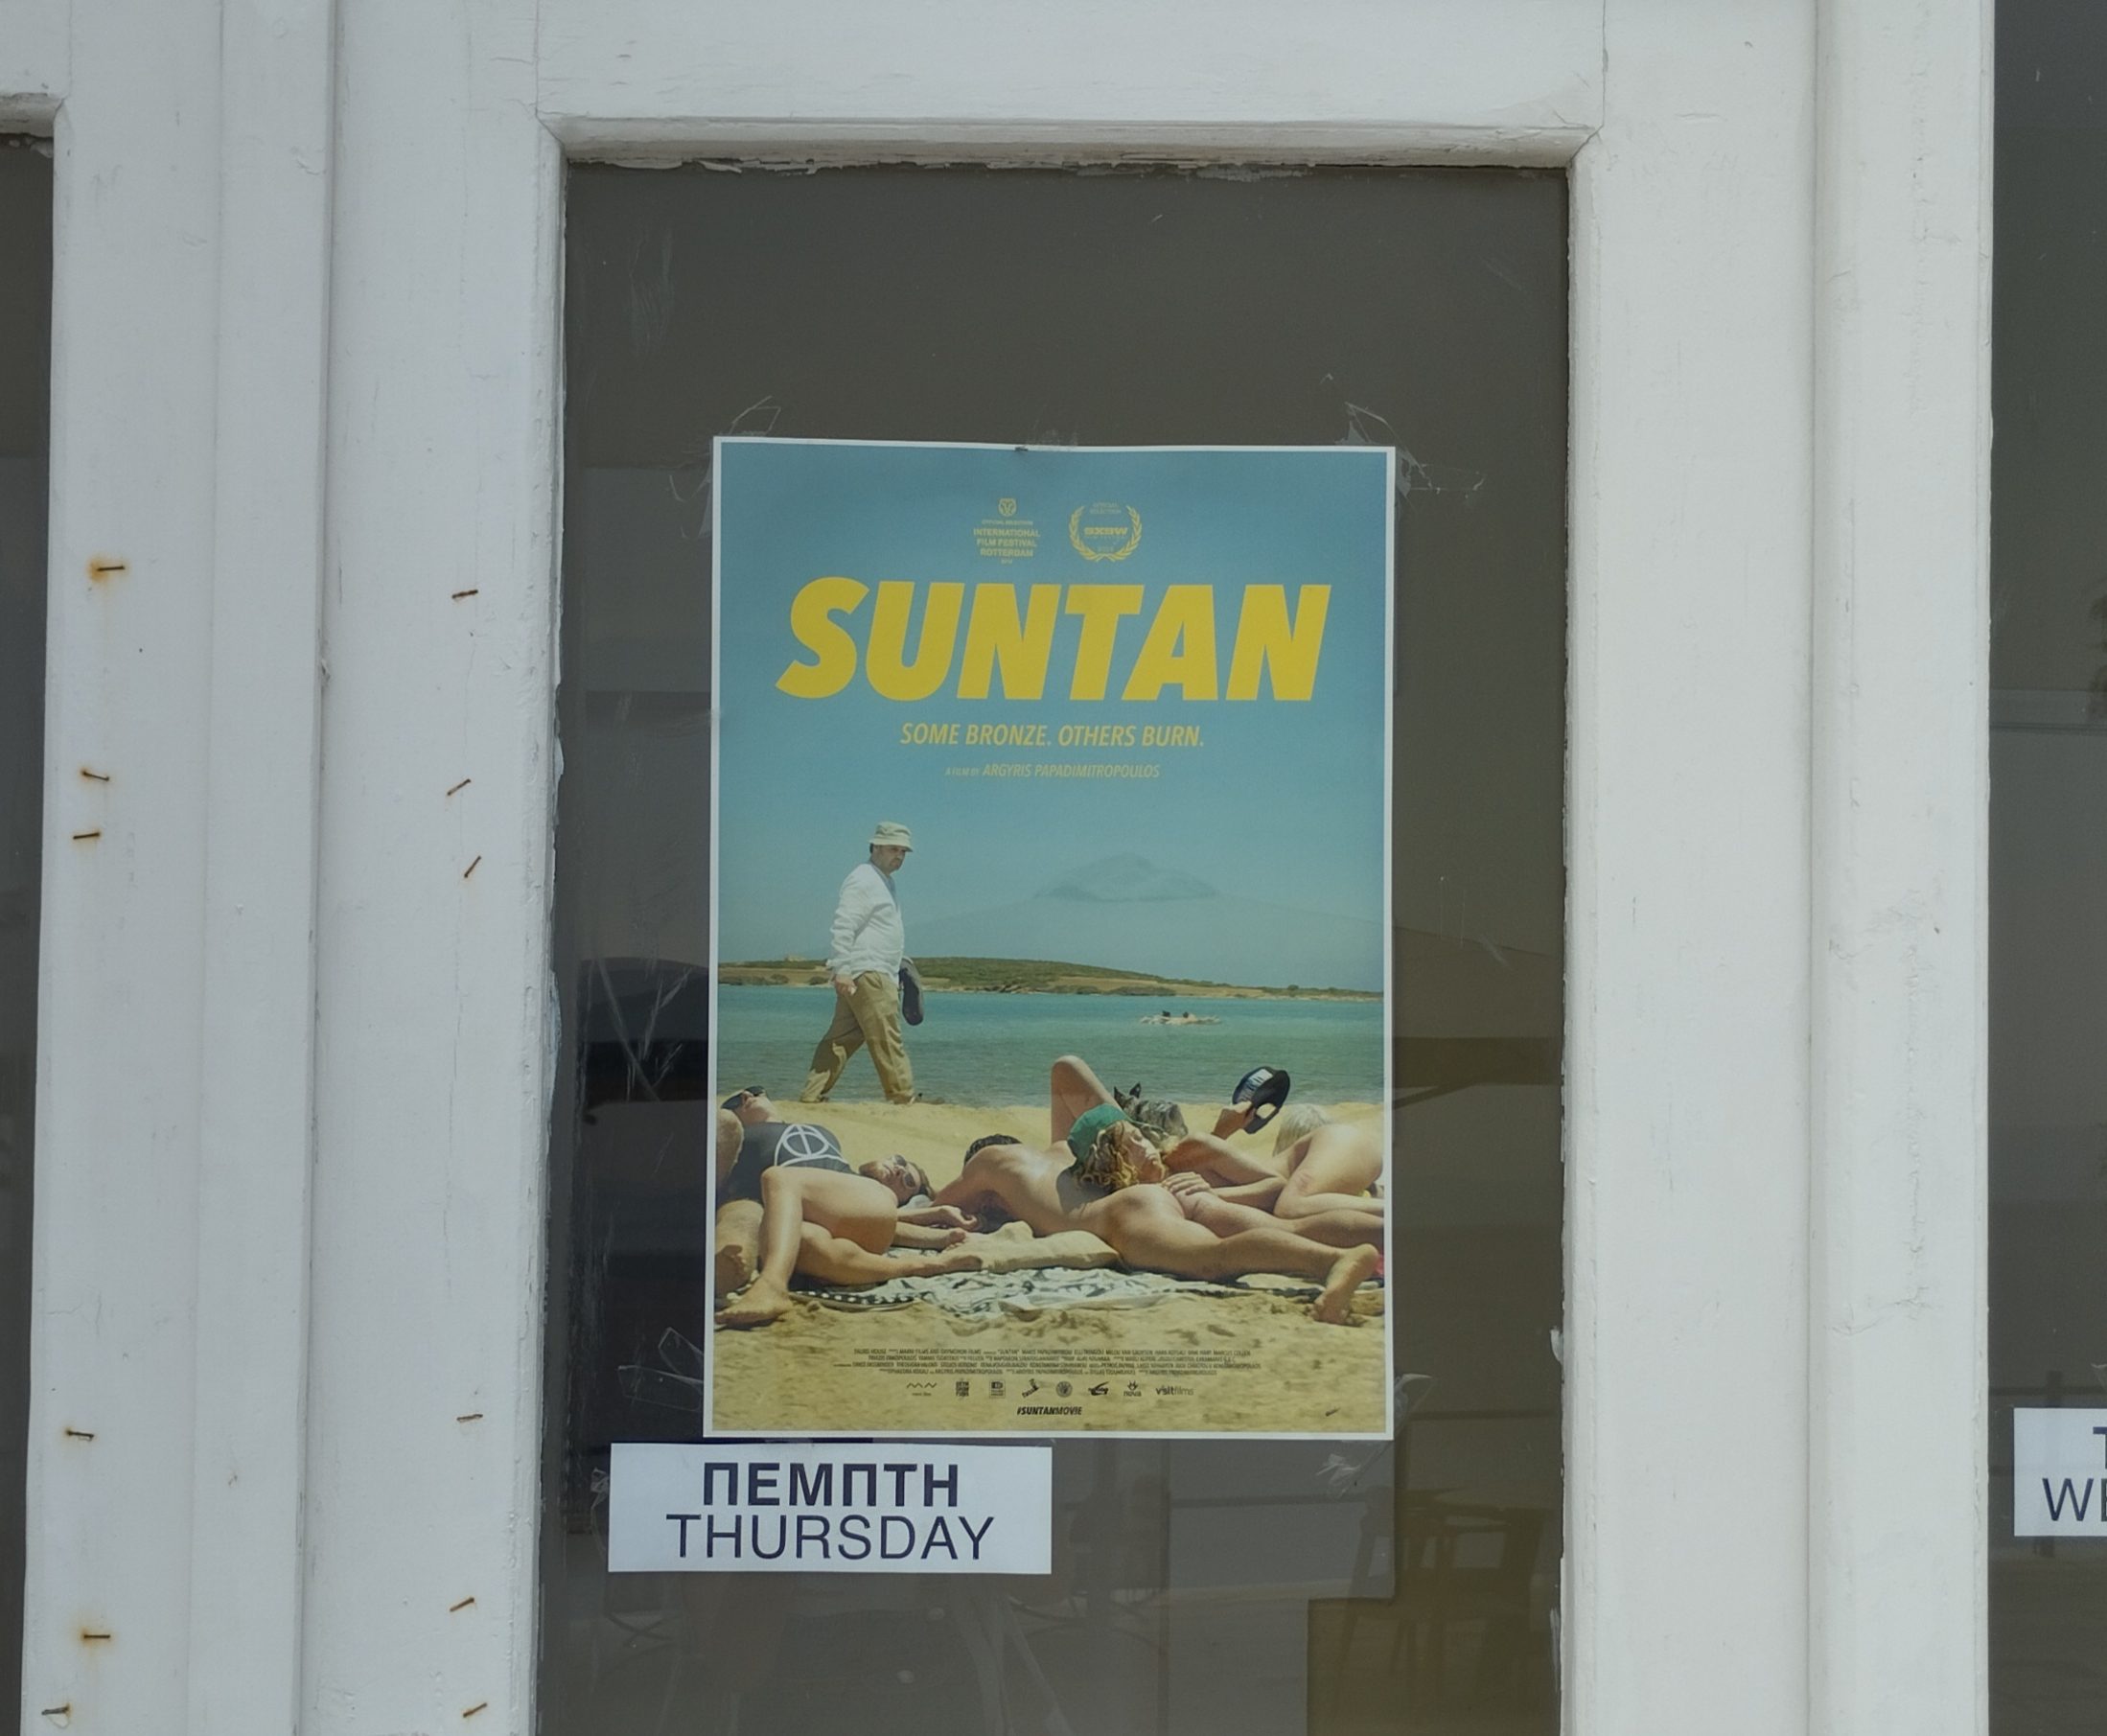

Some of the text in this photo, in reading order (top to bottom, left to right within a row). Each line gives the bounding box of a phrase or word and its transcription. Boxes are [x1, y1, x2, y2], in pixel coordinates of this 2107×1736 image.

[973, 528, 1041, 538] INTERNATIONAL
[998, 539, 1037, 547] FESTIVAL
[980, 548, 1033, 558] ROTTERDAM
[775, 576, 1331, 701] SUNTAN
[900, 723, 1204, 748] SOME BRONZE. OTHERS BURN.
[982, 764, 1031, 776] ARGYRIS
[1033, 764, 1160, 778] PAPADIMITROPOULOS
[1017, 1406, 1082, 1416] #SUNTANMOVIE
[704, 1462, 959, 1507] ΠΕΜΠΤΗ
[2042, 1478, 2107, 1522] W
[666, 1514, 994, 1560] THURSDAY
